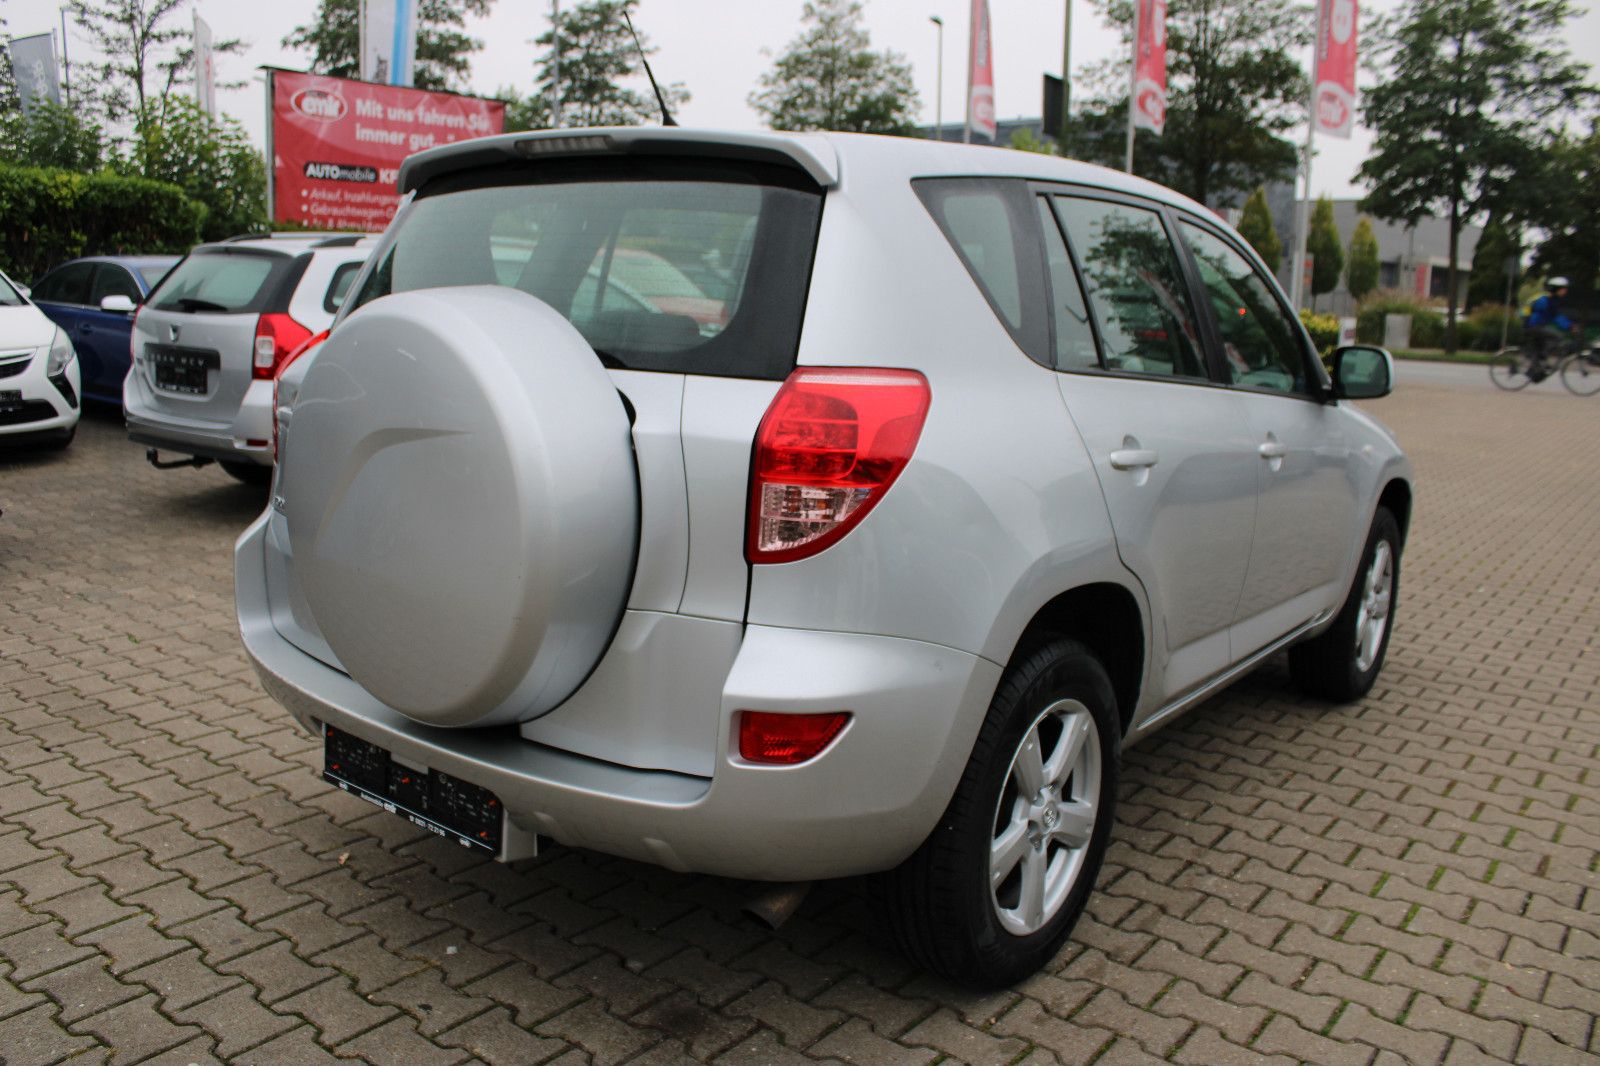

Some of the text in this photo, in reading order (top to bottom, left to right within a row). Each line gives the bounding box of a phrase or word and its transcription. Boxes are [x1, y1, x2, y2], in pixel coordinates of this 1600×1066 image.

[356, 99, 383, 118] Mit
[388, 107, 414, 122] uns
[418, 105, 464, 128] fahren
[306, 163, 400, 184] AUTOmobile KF
